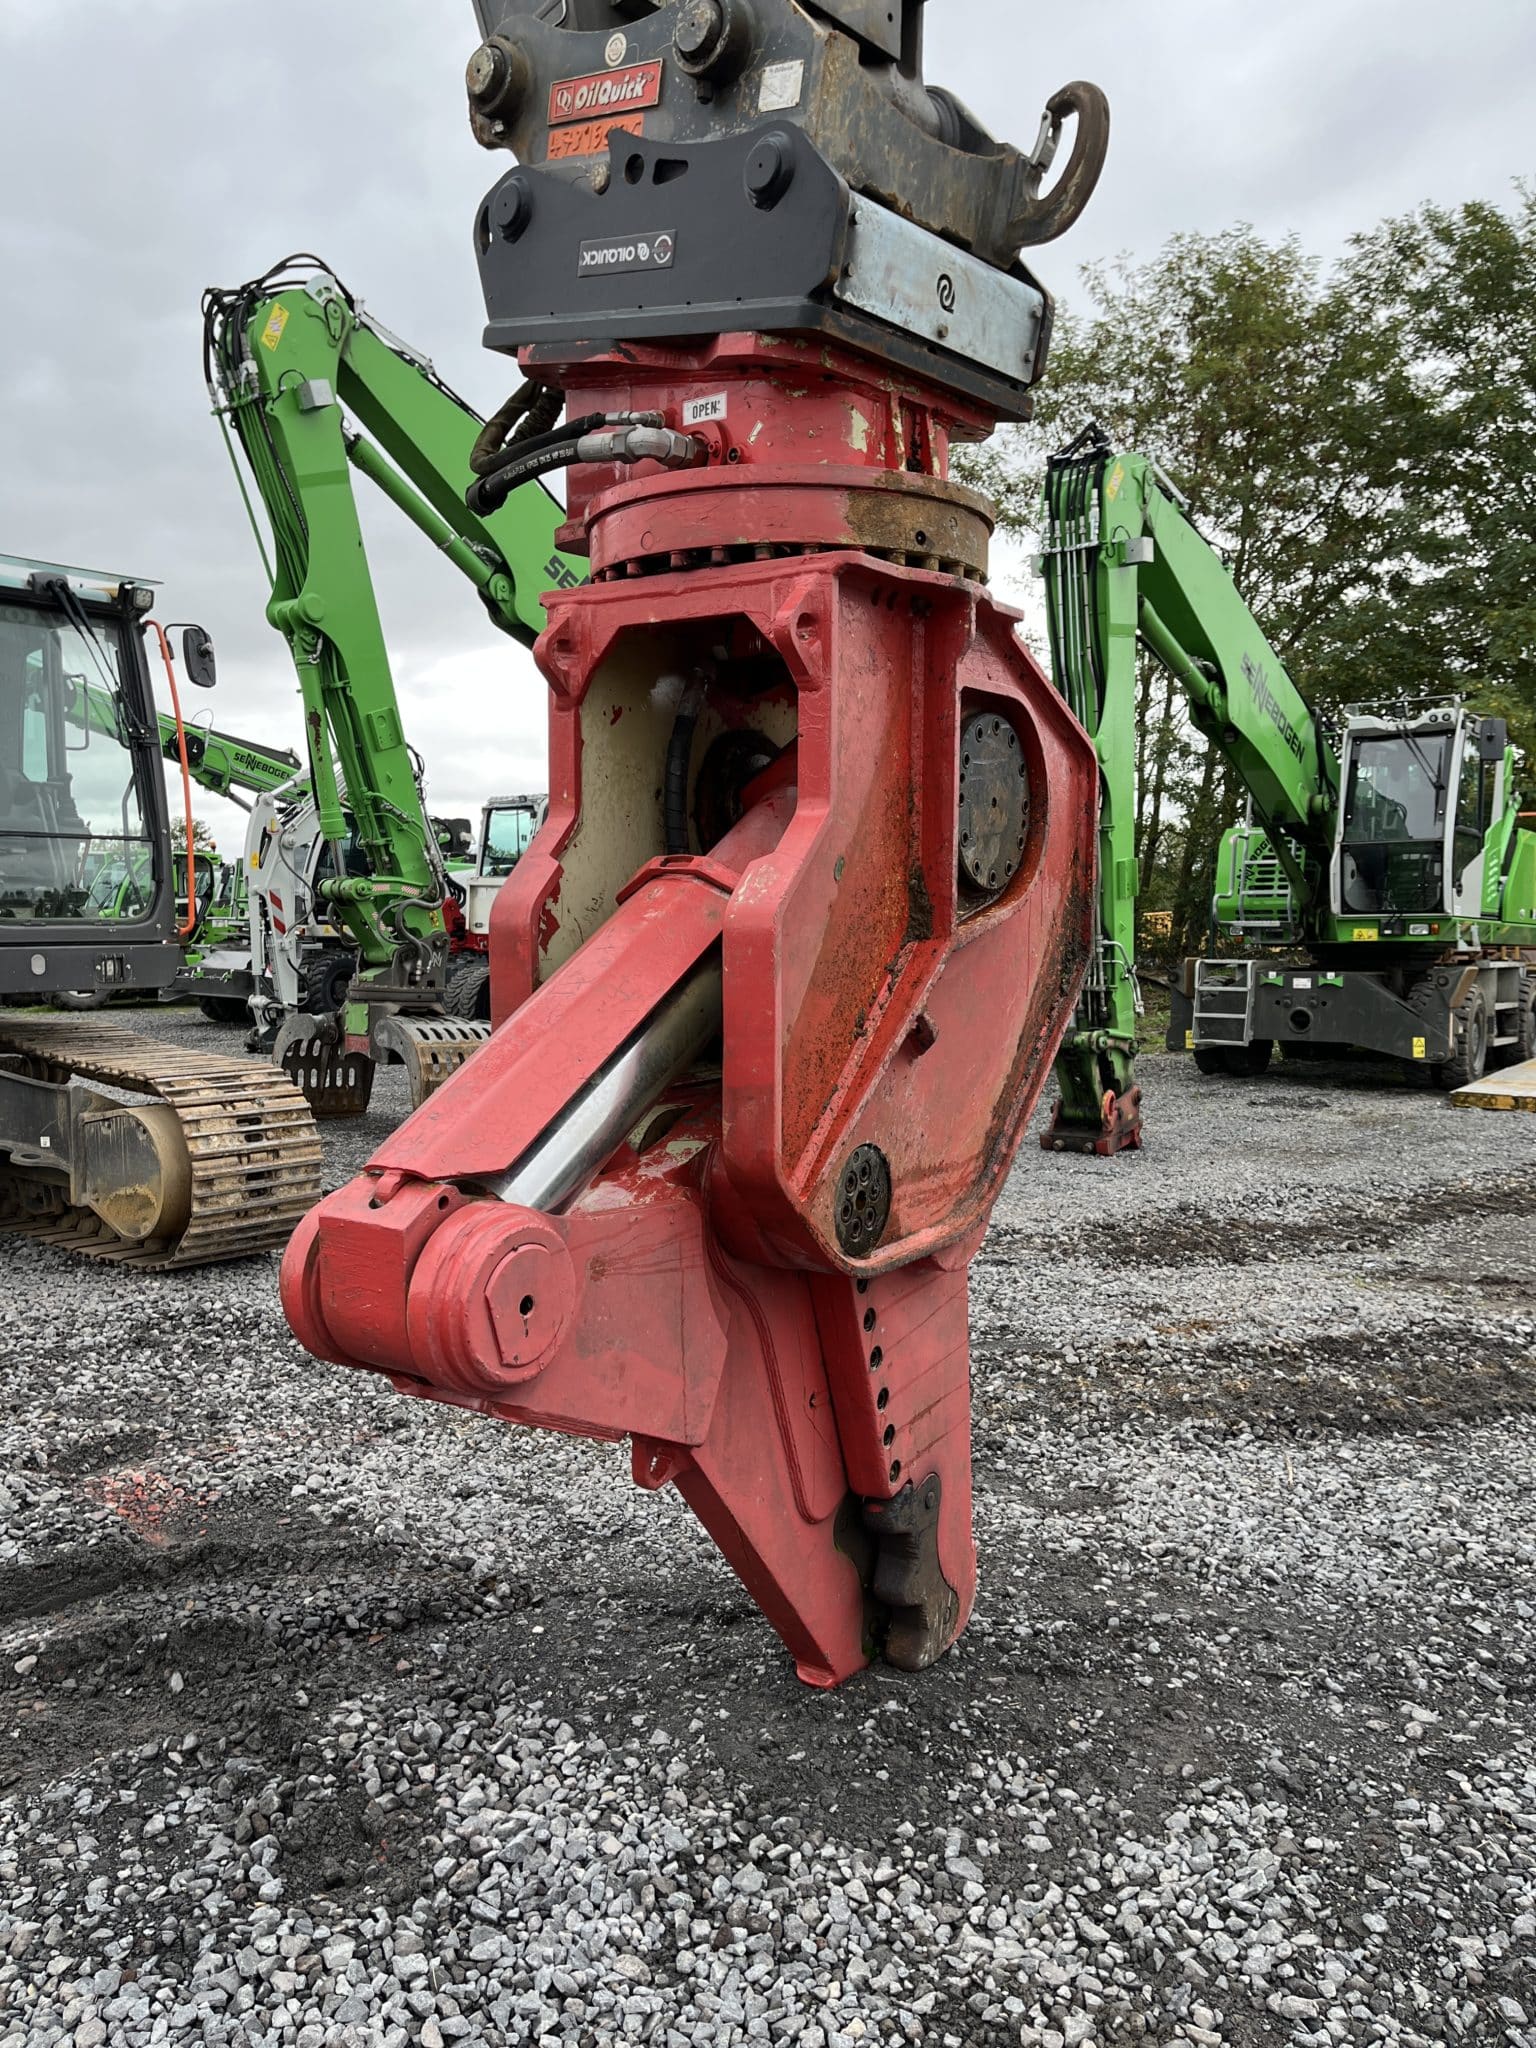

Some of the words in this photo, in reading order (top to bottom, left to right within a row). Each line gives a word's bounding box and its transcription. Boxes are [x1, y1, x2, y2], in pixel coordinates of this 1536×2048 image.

[575, 72, 646, 110] OilQuick
[582, 246, 636, 266] OILQUICK
[1240, 651, 1306, 764] SENNEBOGEN
